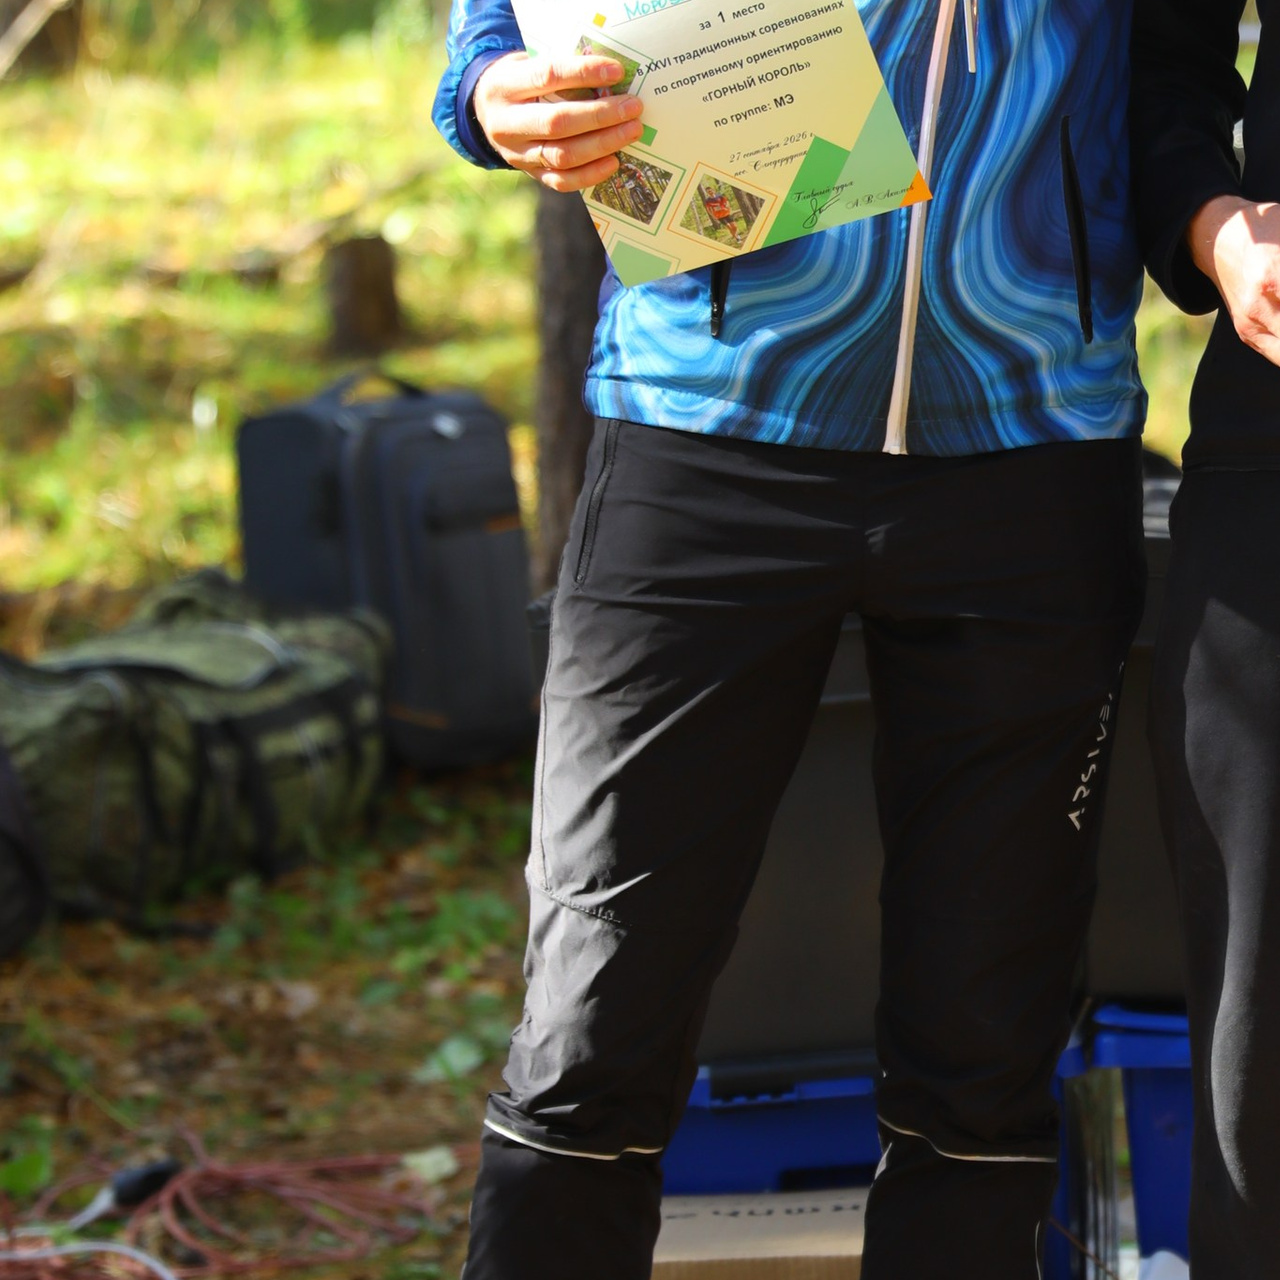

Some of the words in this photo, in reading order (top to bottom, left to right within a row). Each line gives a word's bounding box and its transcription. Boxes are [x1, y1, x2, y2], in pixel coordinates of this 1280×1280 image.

[699, 19, 712, 31] за
[717, 10, 726, 24] 1
[731, 2, 766, 20] место
[636, 67, 644, 77] в
[645, 57, 672, 74] XXVI
[673, 29, 757, 65] традиционных
[758, 0, 845, 35] соревнованиях
[653, 85, 669, 96] по
[670, 57, 744, 90] спортивному
[745, 25, 843, 65] ориентированию
[702, 76, 756, 103] «ГОРНЫЙ
[757, 61, 811, 84] КОРОЛЬ»
[713, 117, 729, 128] по
[730, 102, 772, 124] группе:
[773, 93, 795, 108] МЭ
[729, 151, 741, 163] 27
